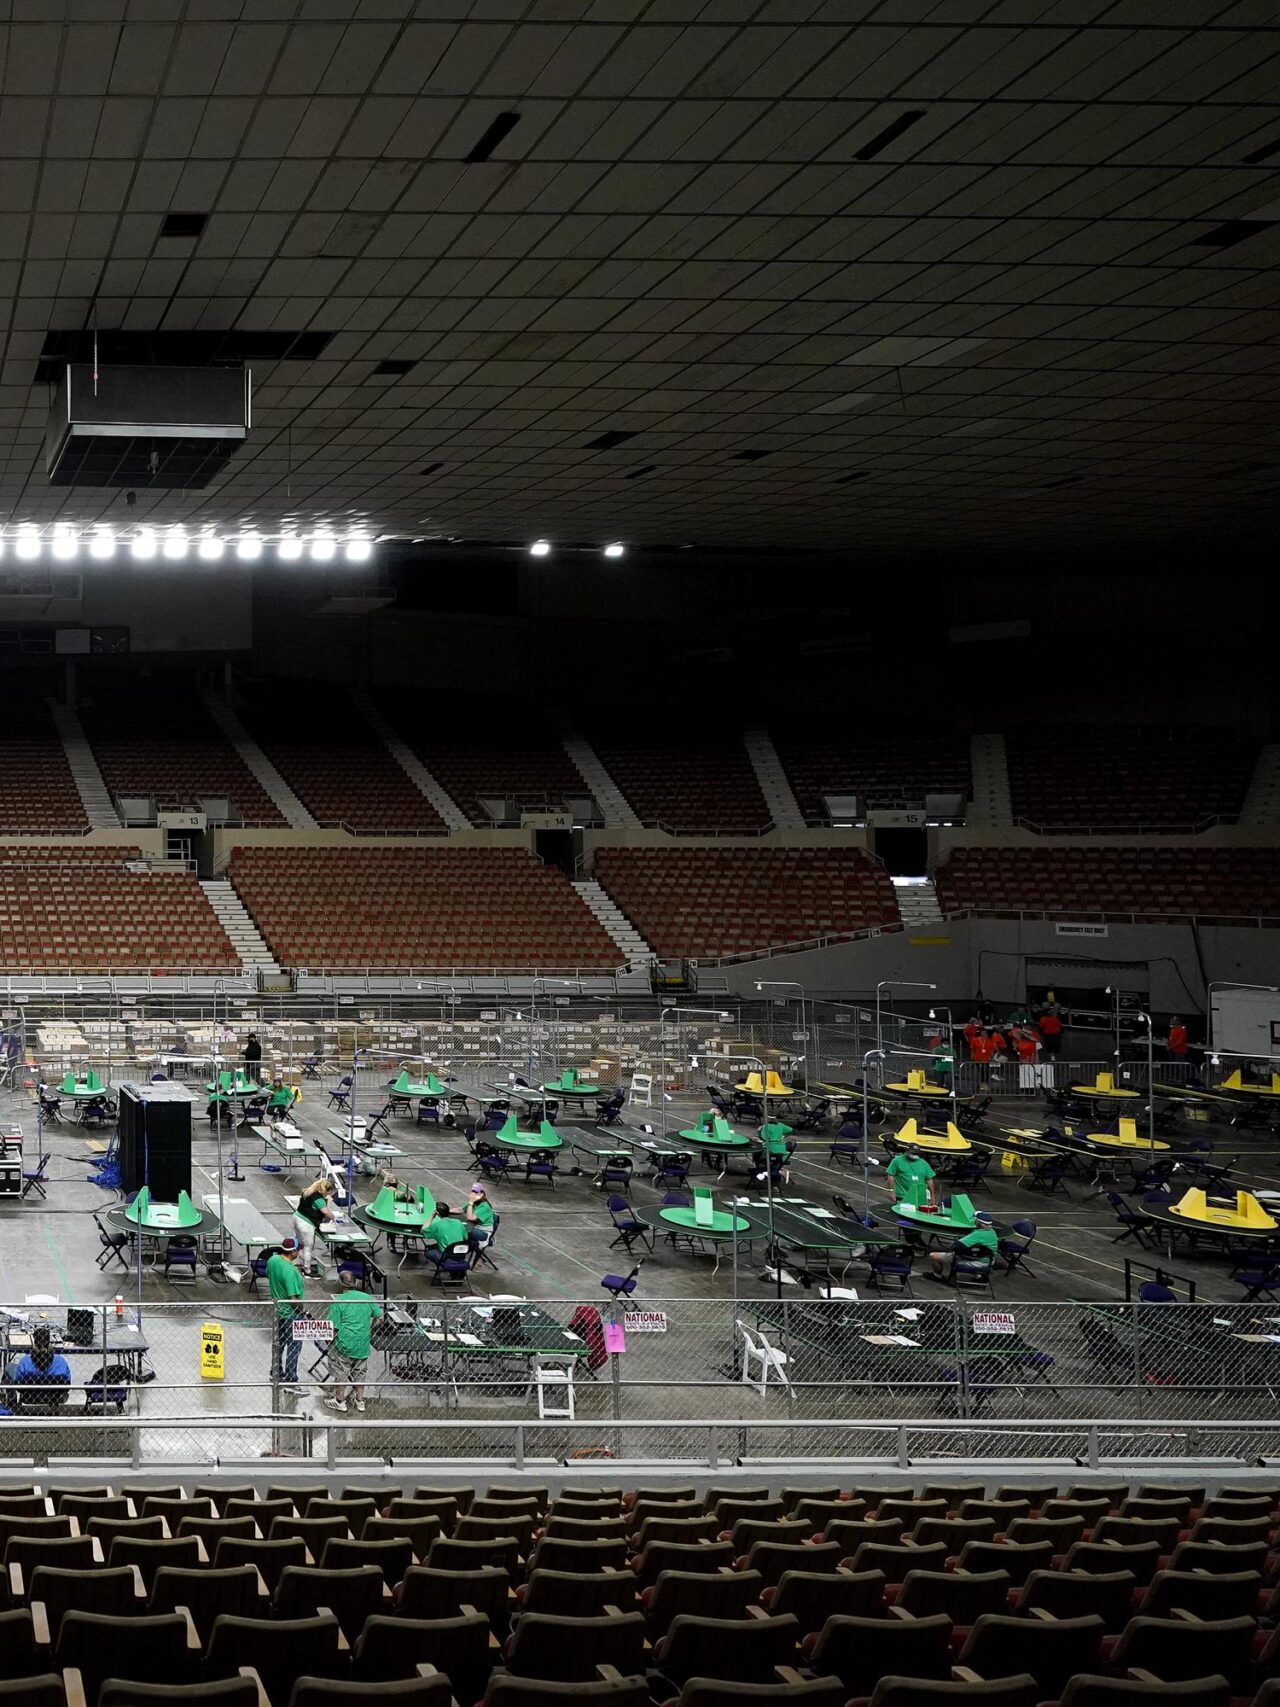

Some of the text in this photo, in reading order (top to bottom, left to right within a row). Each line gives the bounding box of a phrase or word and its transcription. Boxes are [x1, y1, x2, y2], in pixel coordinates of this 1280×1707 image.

[555, 818, 565, 826] 14
[905, 815, 918, 823] 15
[625, 1313, 665, 1322] NATIONAL
[974, 1314, 1014, 1324] NATIONAL
[294, 1321, 332, 1331] NATIONAL
[204, 1333, 221, 1341] NOTICE
